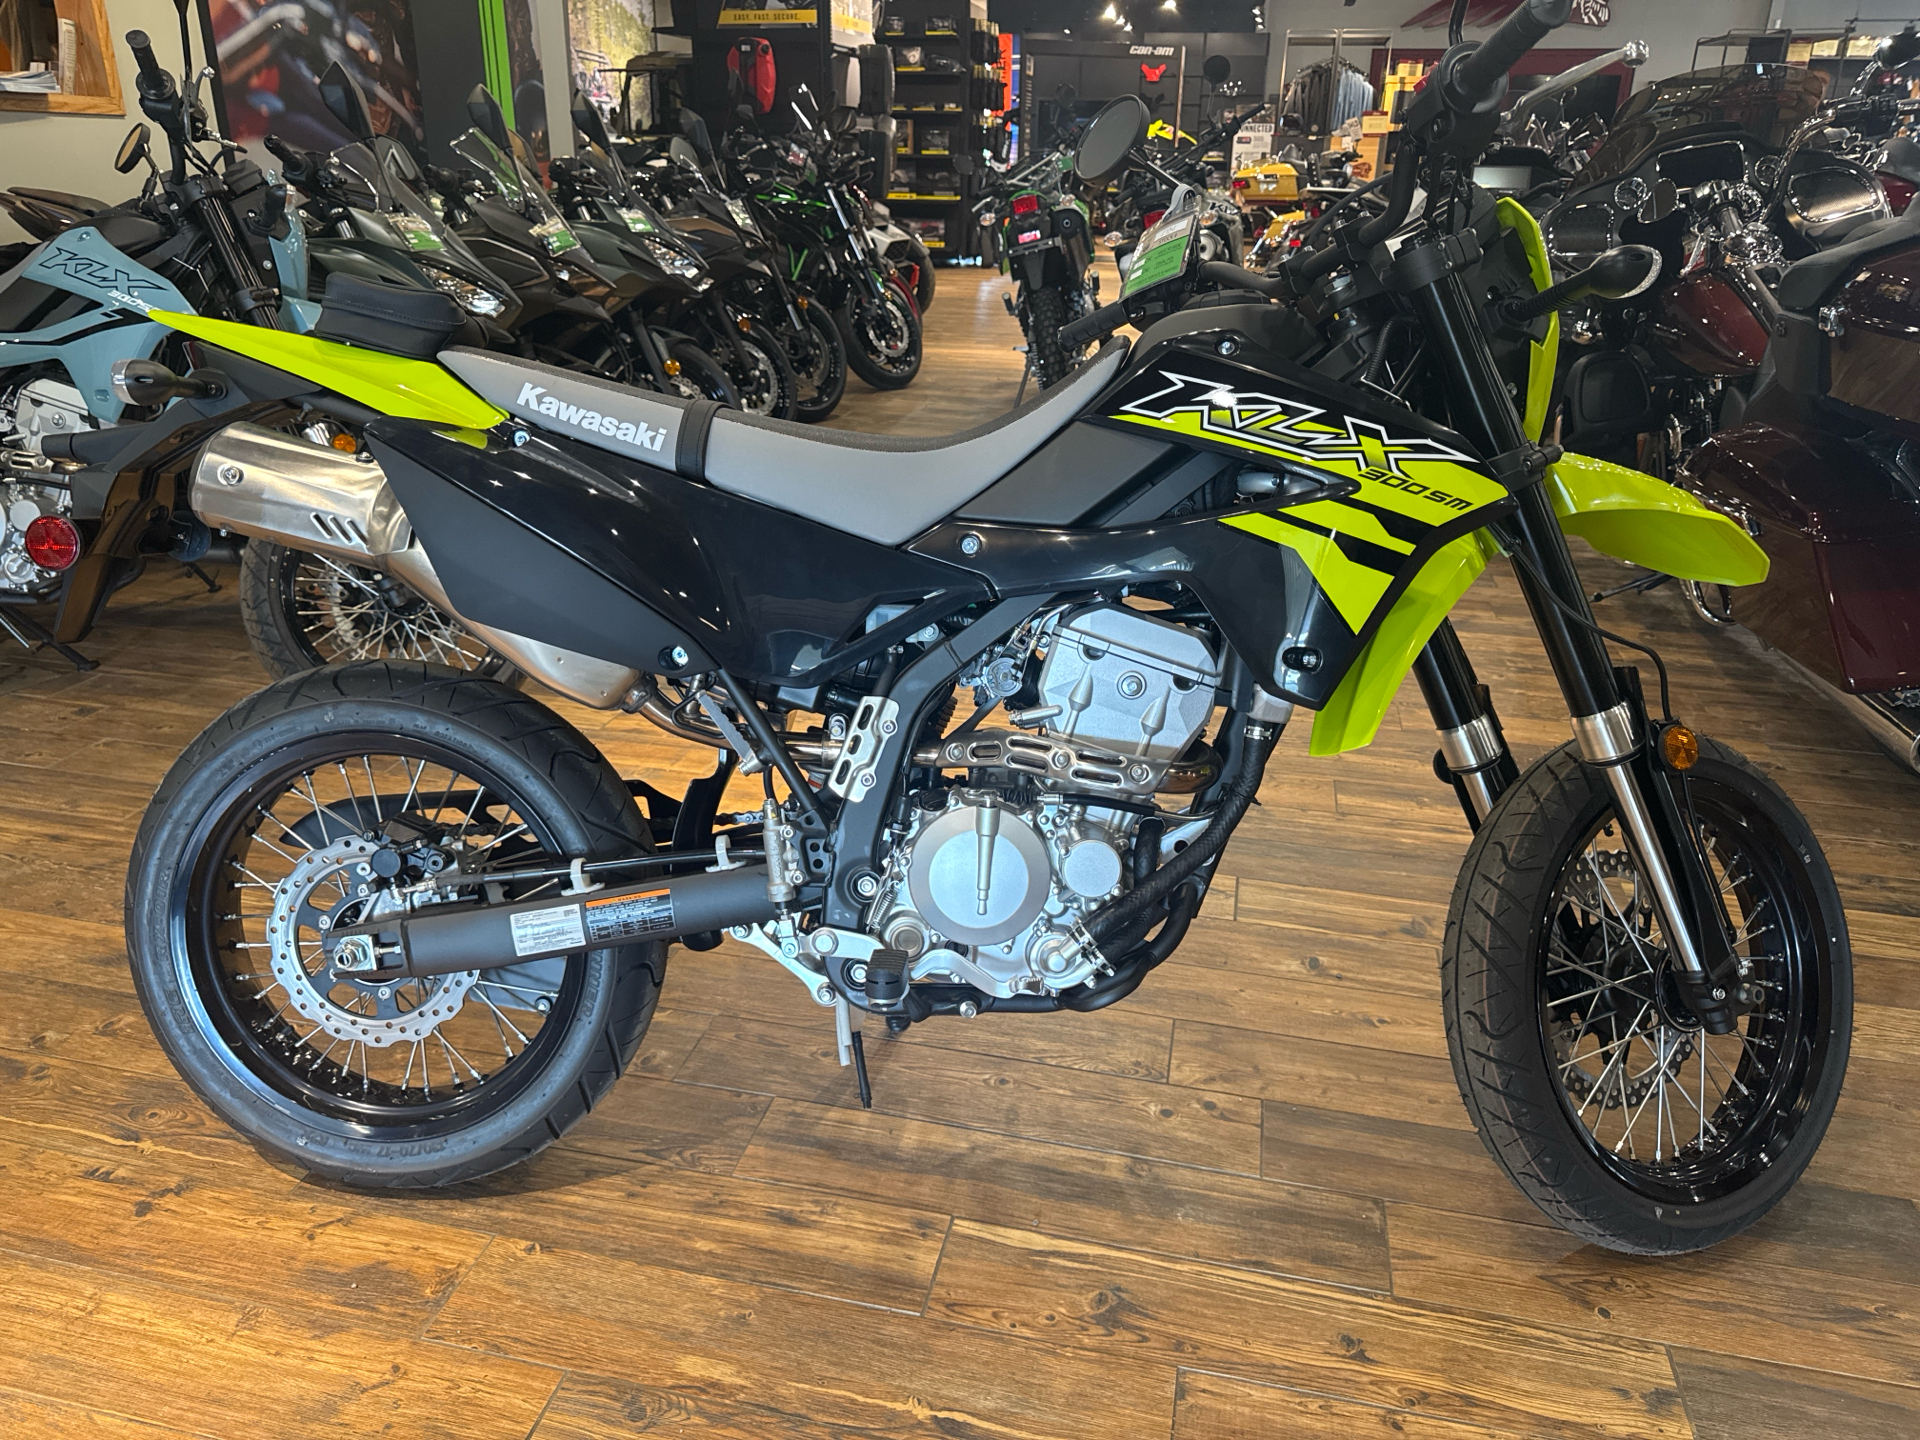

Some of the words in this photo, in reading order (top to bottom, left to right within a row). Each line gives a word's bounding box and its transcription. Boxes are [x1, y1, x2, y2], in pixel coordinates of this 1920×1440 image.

[733, 13, 752, 21] EASY.
[754, 13, 771, 21] FAST.
[773, 12, 801, 21] SECURE.
[38, 246, 170, 298] KLX
[516, 382, 667, 452] Kawasaki
[1118, 369, 1482, 480] KLX
[153, 870, 172, 962] RX-01R
